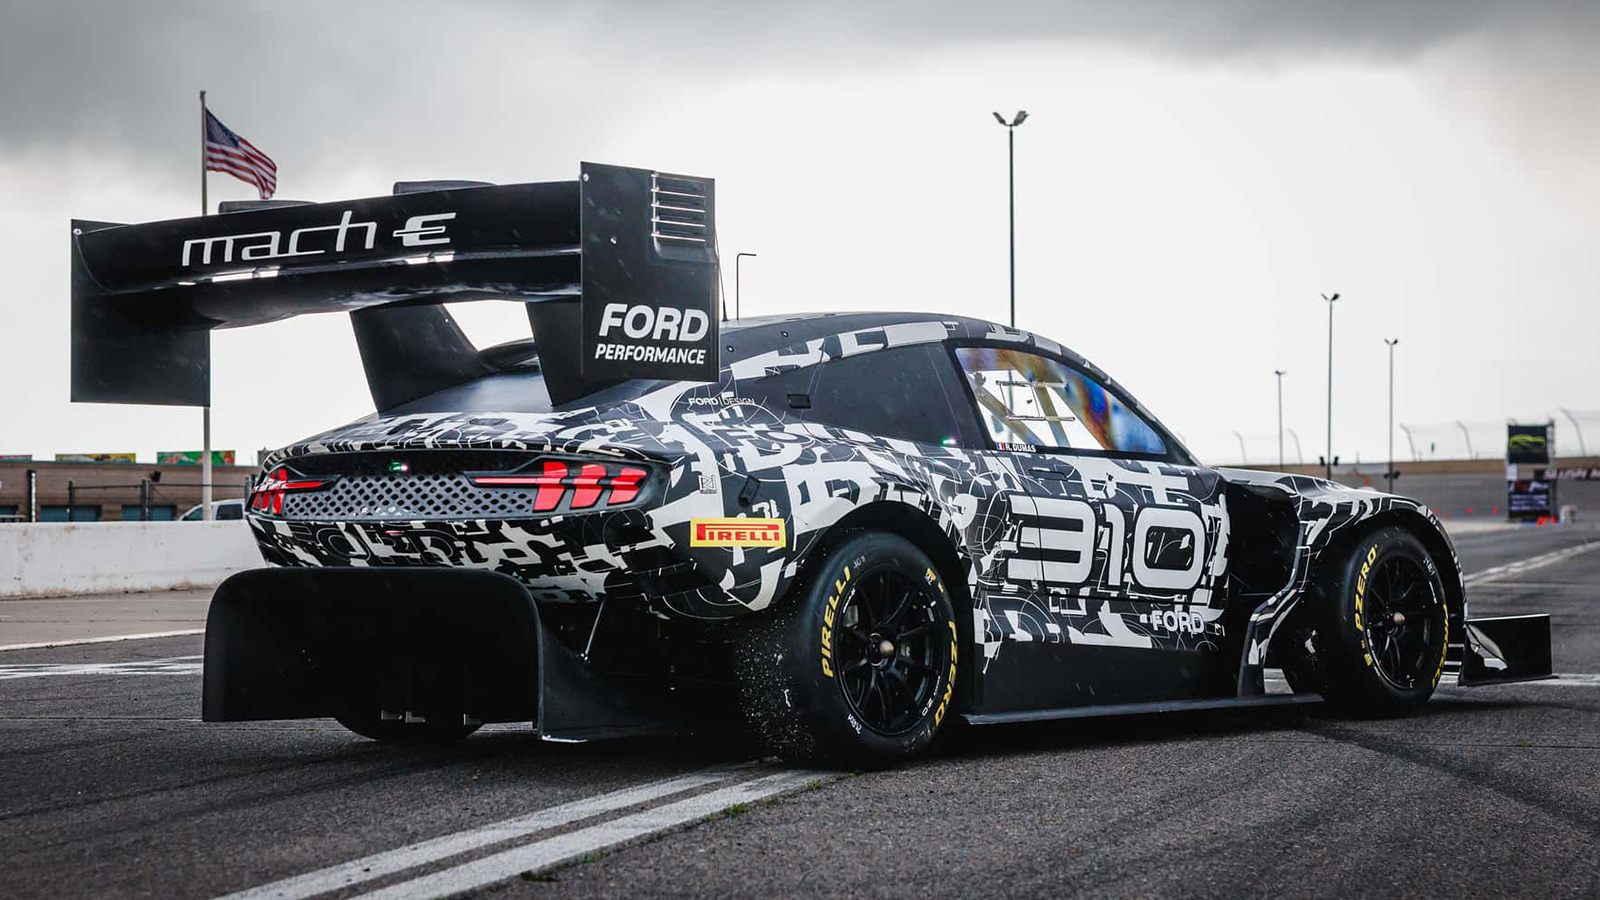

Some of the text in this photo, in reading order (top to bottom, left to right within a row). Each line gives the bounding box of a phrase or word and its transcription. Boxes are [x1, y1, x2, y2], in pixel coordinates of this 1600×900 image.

[181, 210, 377, 267] mach
[599, 303, 709, 342] FORD
[595, 343, 706, 365] PERFORMANCE
[688, 397, 718, 406] FORD
[1012, 443, 1037, 452] DUMAS
[697, 523, 780, 542] PIRELLI
[1008, 494, 1206, 590] 310
[821, 565, 851, 678] PIRELLI
[1152, 610, 1205, 634] FORD
